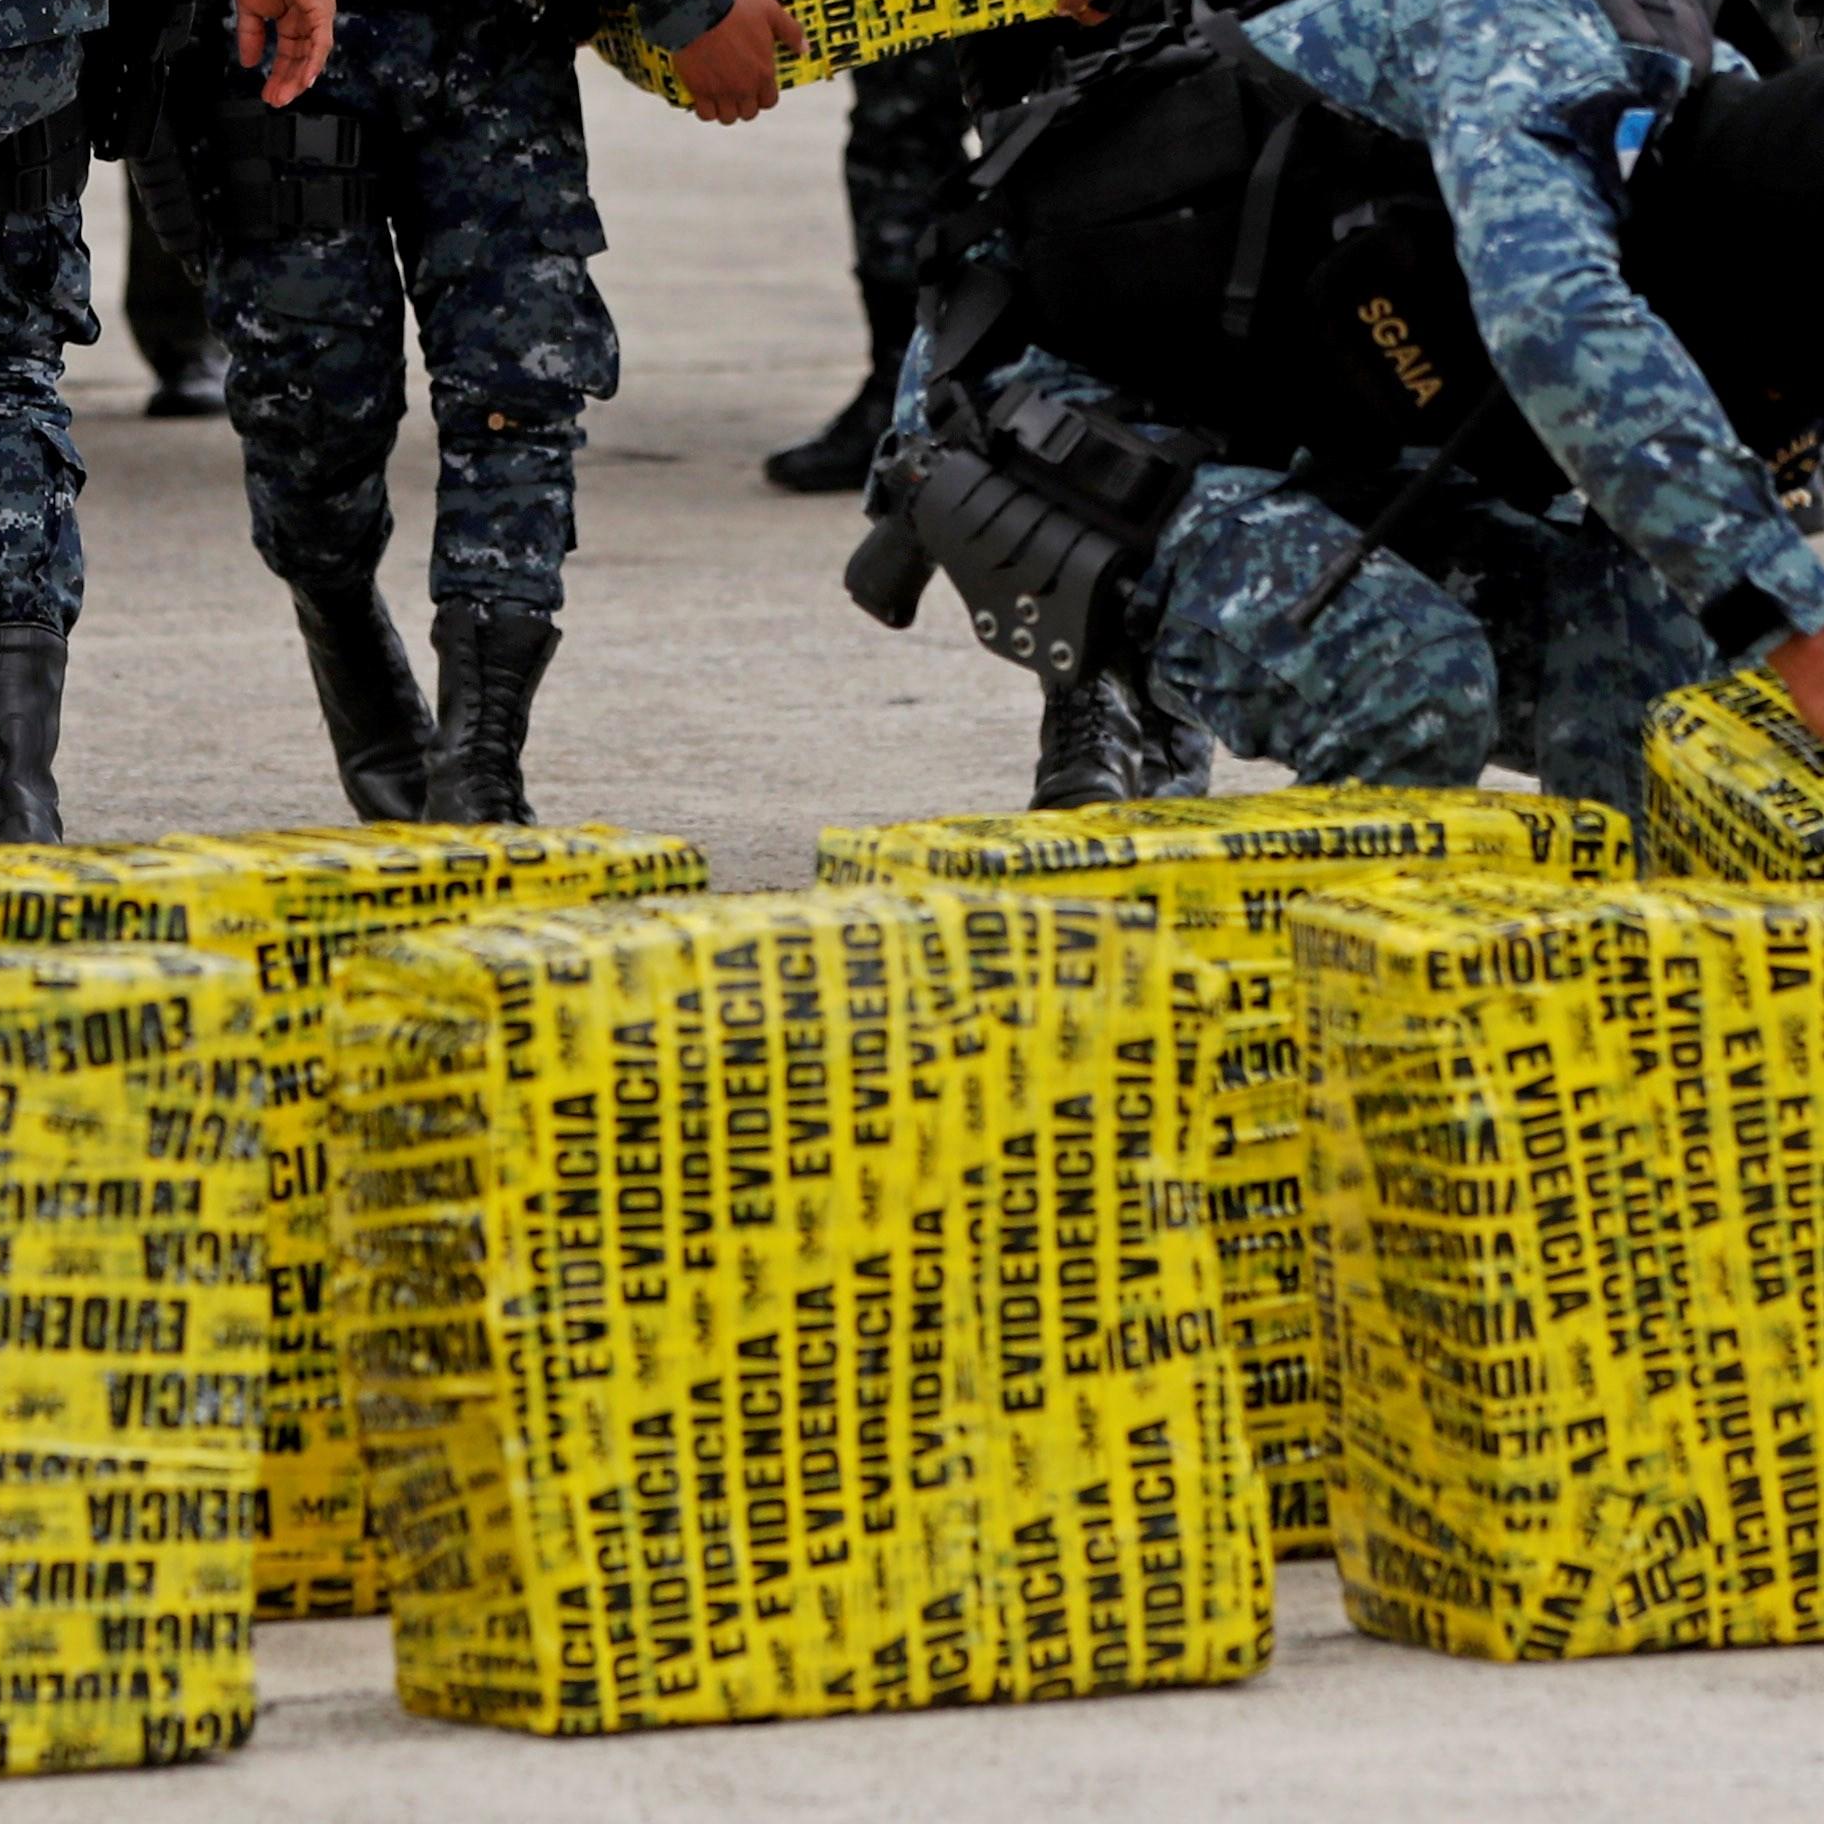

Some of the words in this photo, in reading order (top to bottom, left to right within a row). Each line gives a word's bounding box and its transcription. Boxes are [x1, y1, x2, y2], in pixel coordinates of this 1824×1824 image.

[1357, 321, 1443, 409] SGAIA
[616, 1021, 668, 1305] EVIDENCIA
[673, 988, 717, 1271] EVIDENCIA
[711, 935, 777, 1228] EVIDENCIA
[1505, 1042, 1592, 1322] EVIDENCIA
[1664, 956, 1721, 1228] EVIDENCIA
[1722, 1026, 1787, 1306] EVIDENCIA
[551, 1090, 612, 1384] EVIDENCIA
[909, 1208, 952, 1492] EVIDENCIA
[998, 1132, 1046, 1415] EVIDENCIA
[1054, 1093, 1100, 1380] EVIDENCIA
[688, 1378, 748, 1662] EVIDENCIA
[736, 1331, 792, 1622] EVIDENCIA
[795, 1283, 850, 1568] EVIDENCIA
[855, 1252, 898, 1534] EVIDENCIA
[1707, 1326, 1775, 1594] EVIDENCIA
[630, 1411, 700, 1699] EVIDENCIA
